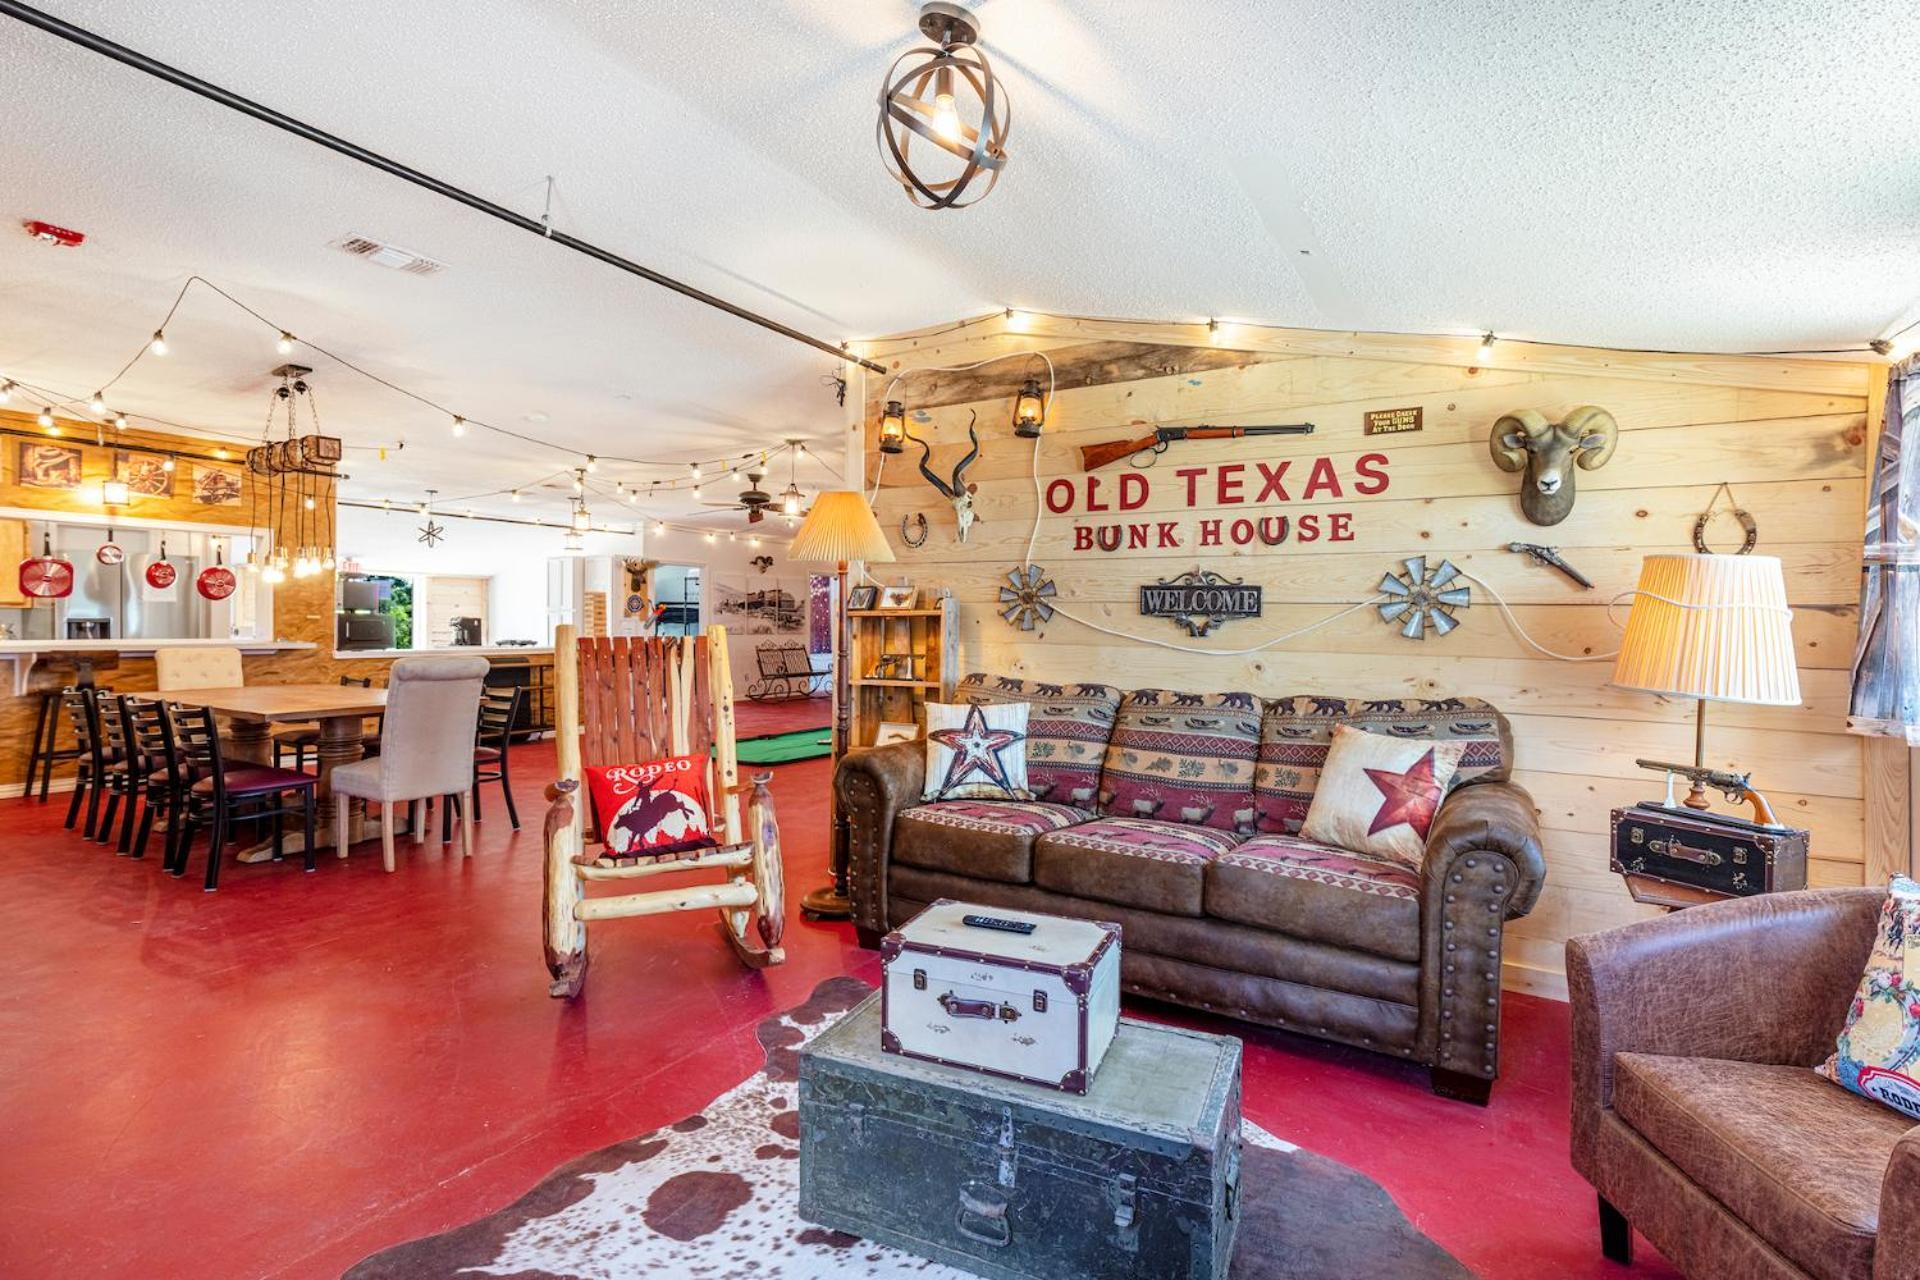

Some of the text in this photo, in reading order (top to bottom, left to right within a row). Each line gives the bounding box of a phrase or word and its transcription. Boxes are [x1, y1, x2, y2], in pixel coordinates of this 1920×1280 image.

[1392, 415, 1415, 425] GUNS
[1046, 453, 1390, 514] OLD TEXAS
[1073, 513, 1355, 551] BUNK HOUSE
[1143, 589, 1258, 612] WELCOME
[606, 760, 692, 794] RODEO
